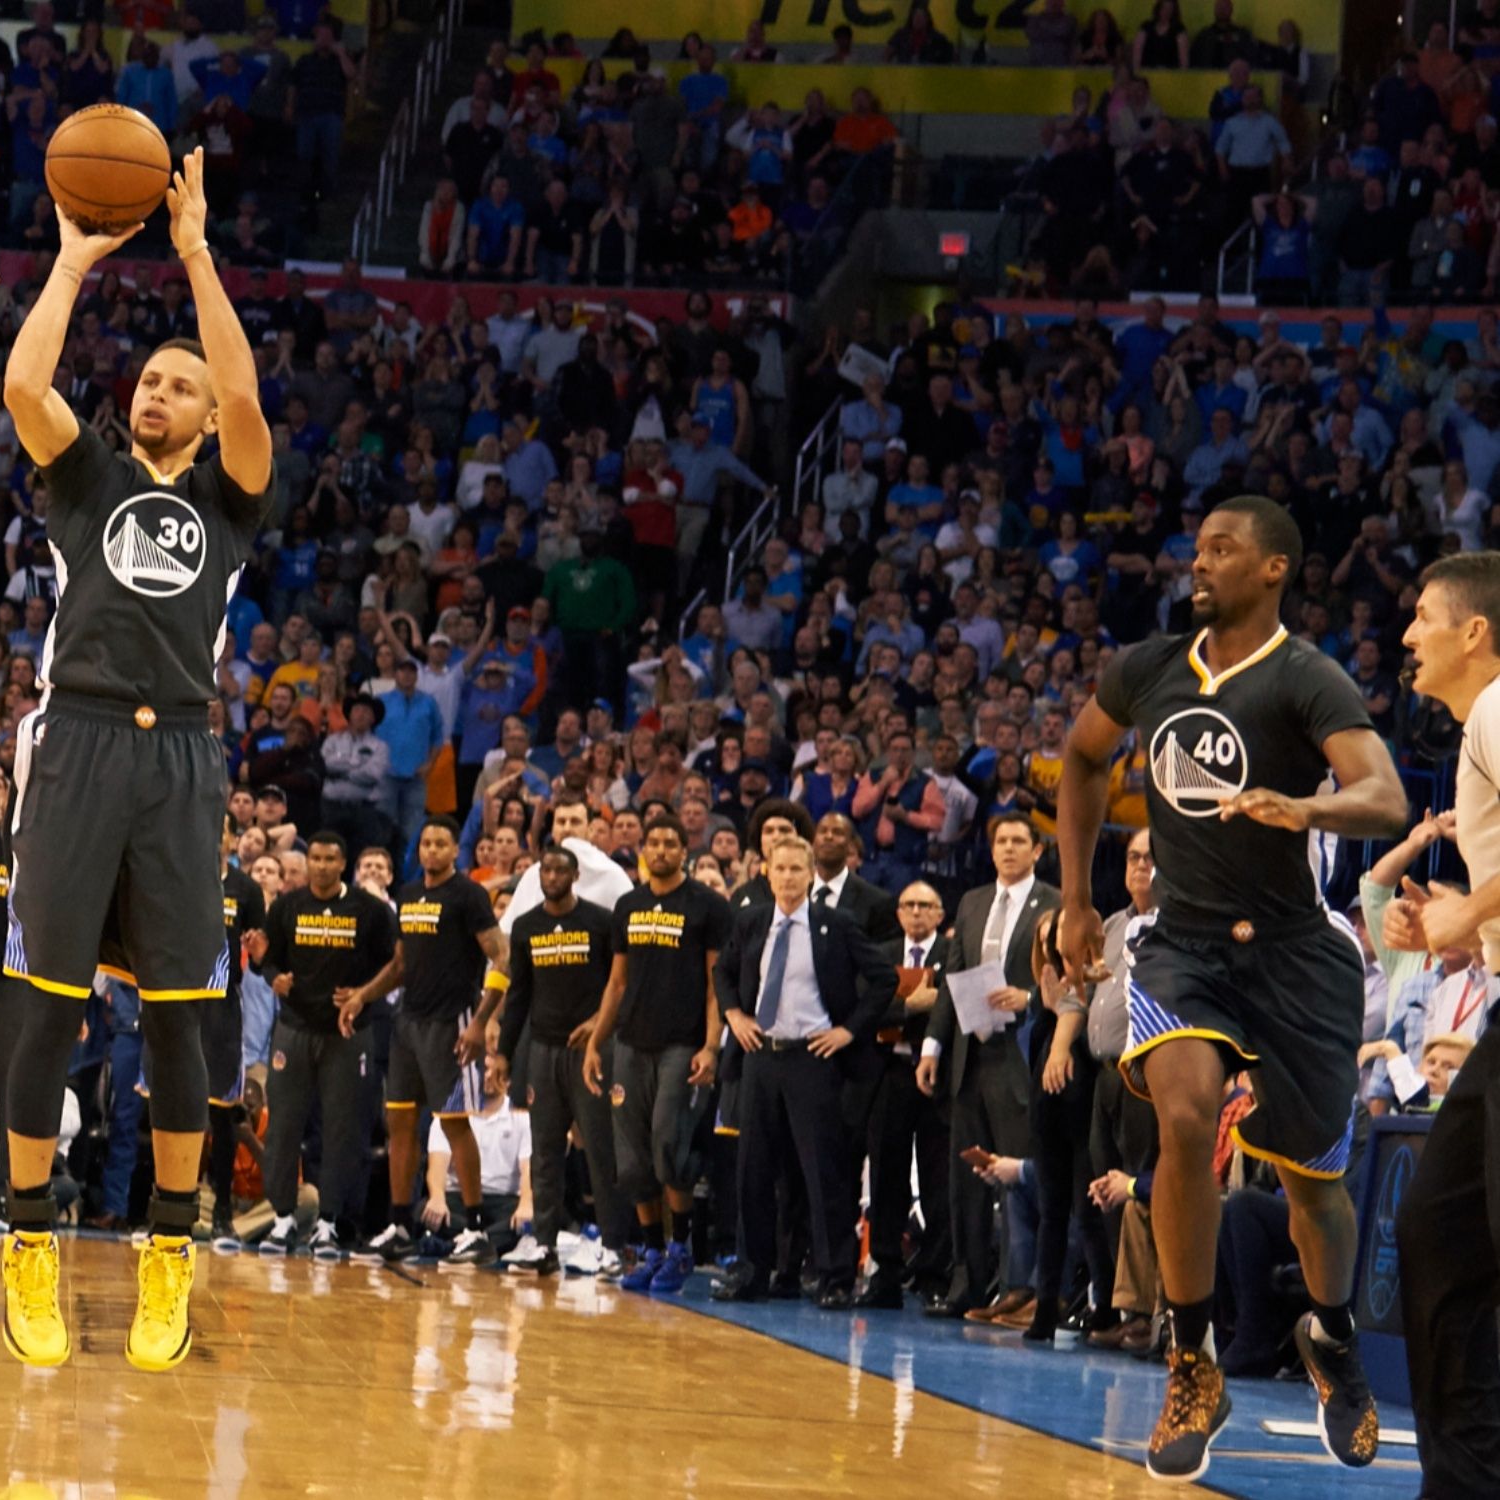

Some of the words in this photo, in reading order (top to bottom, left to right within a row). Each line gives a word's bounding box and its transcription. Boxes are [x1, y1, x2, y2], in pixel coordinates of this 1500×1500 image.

[156, 516, 200, 553] 30
[1194, 730, 1236, 766] 40
[297, 914, 357, 929] WARRIORS
[629, 911, 685, 928] WARRIORS
[295, 934, 355, 948] BASKETBALL
[530, 931, 589, 948] WARRIORS
[627, 932, 680, 948] BASKETBALL
[532, 953, 589, 968] BASKETBALL
